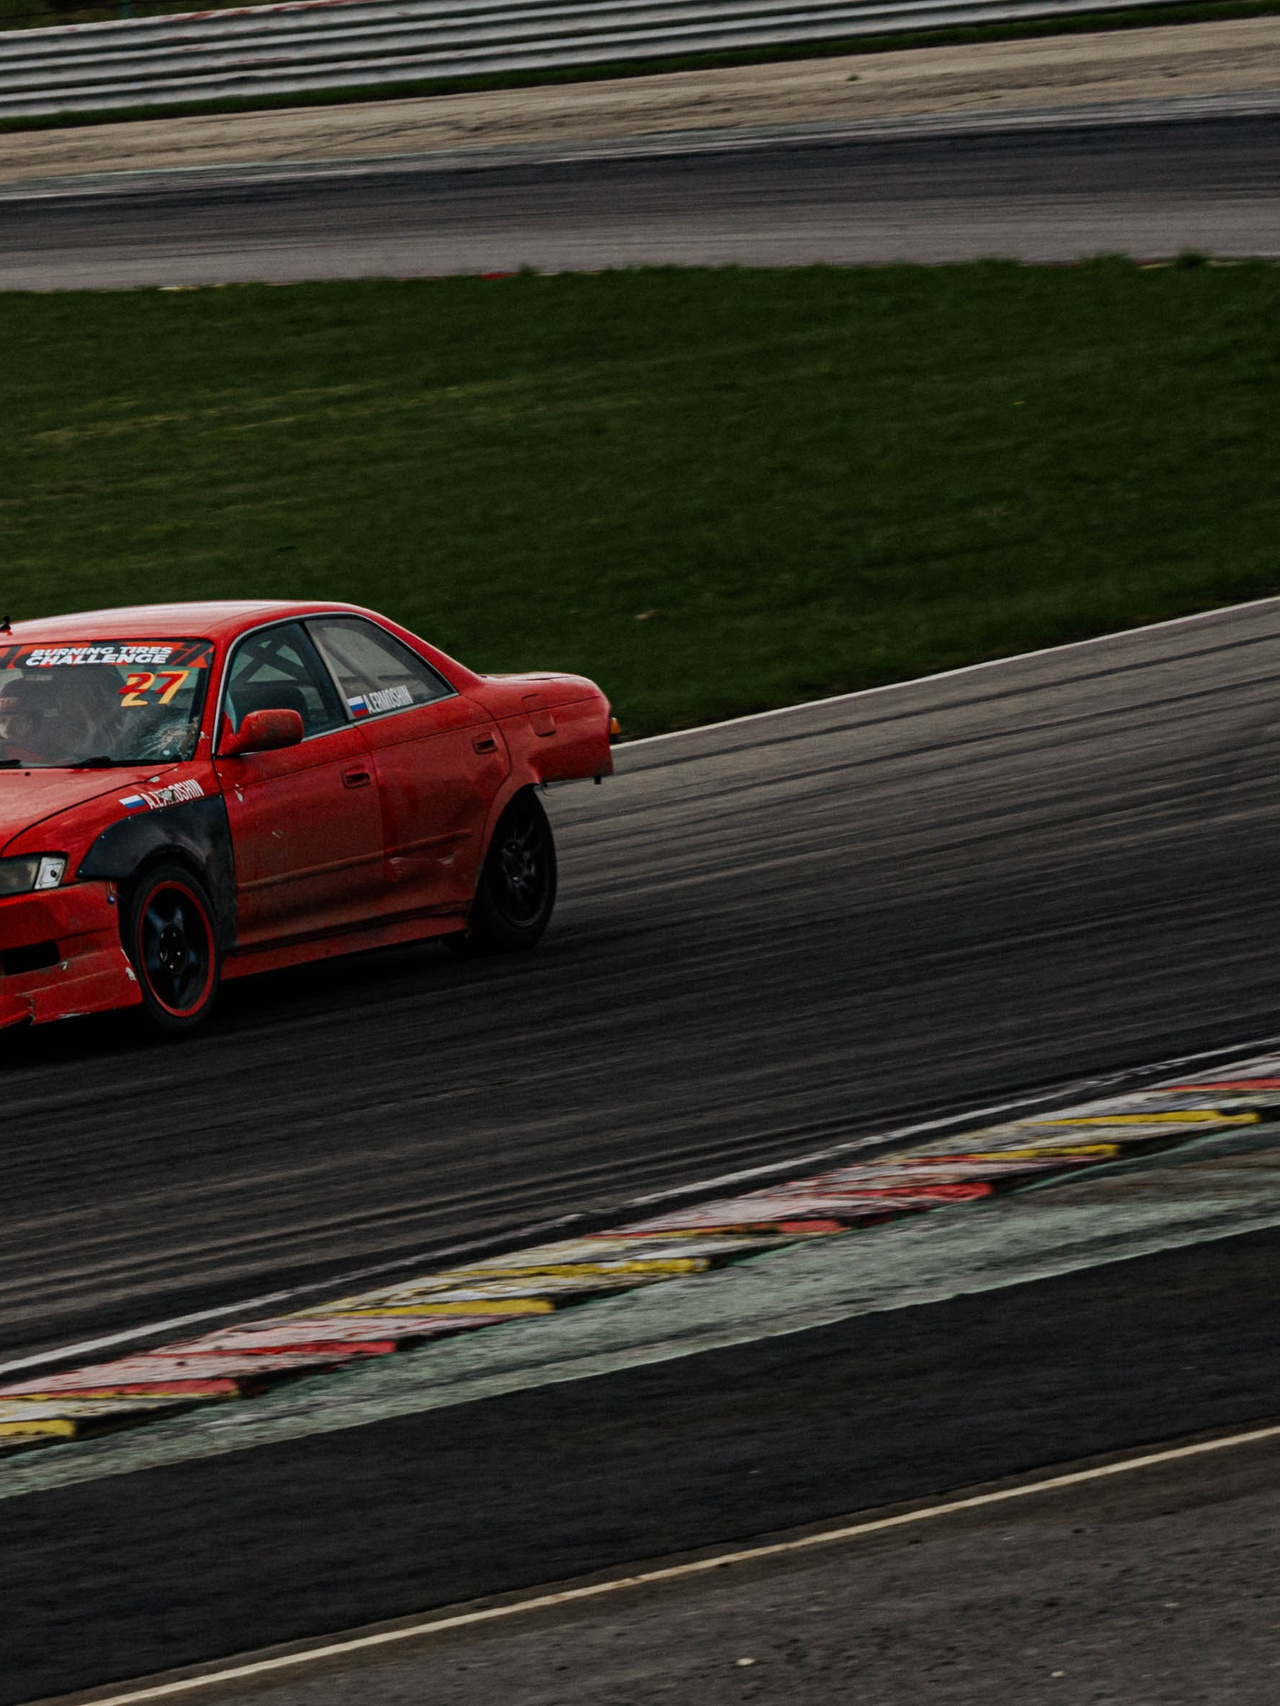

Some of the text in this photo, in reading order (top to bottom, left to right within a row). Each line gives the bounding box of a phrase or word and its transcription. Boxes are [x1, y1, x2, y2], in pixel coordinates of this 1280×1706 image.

[25, 653, 169, 666] CHALLENGE
[31, 646, 173, 657] BURNING TIRES
[118, 670, 190, 707] 27
[140, 778, 205, 809] A.EOSHIN
